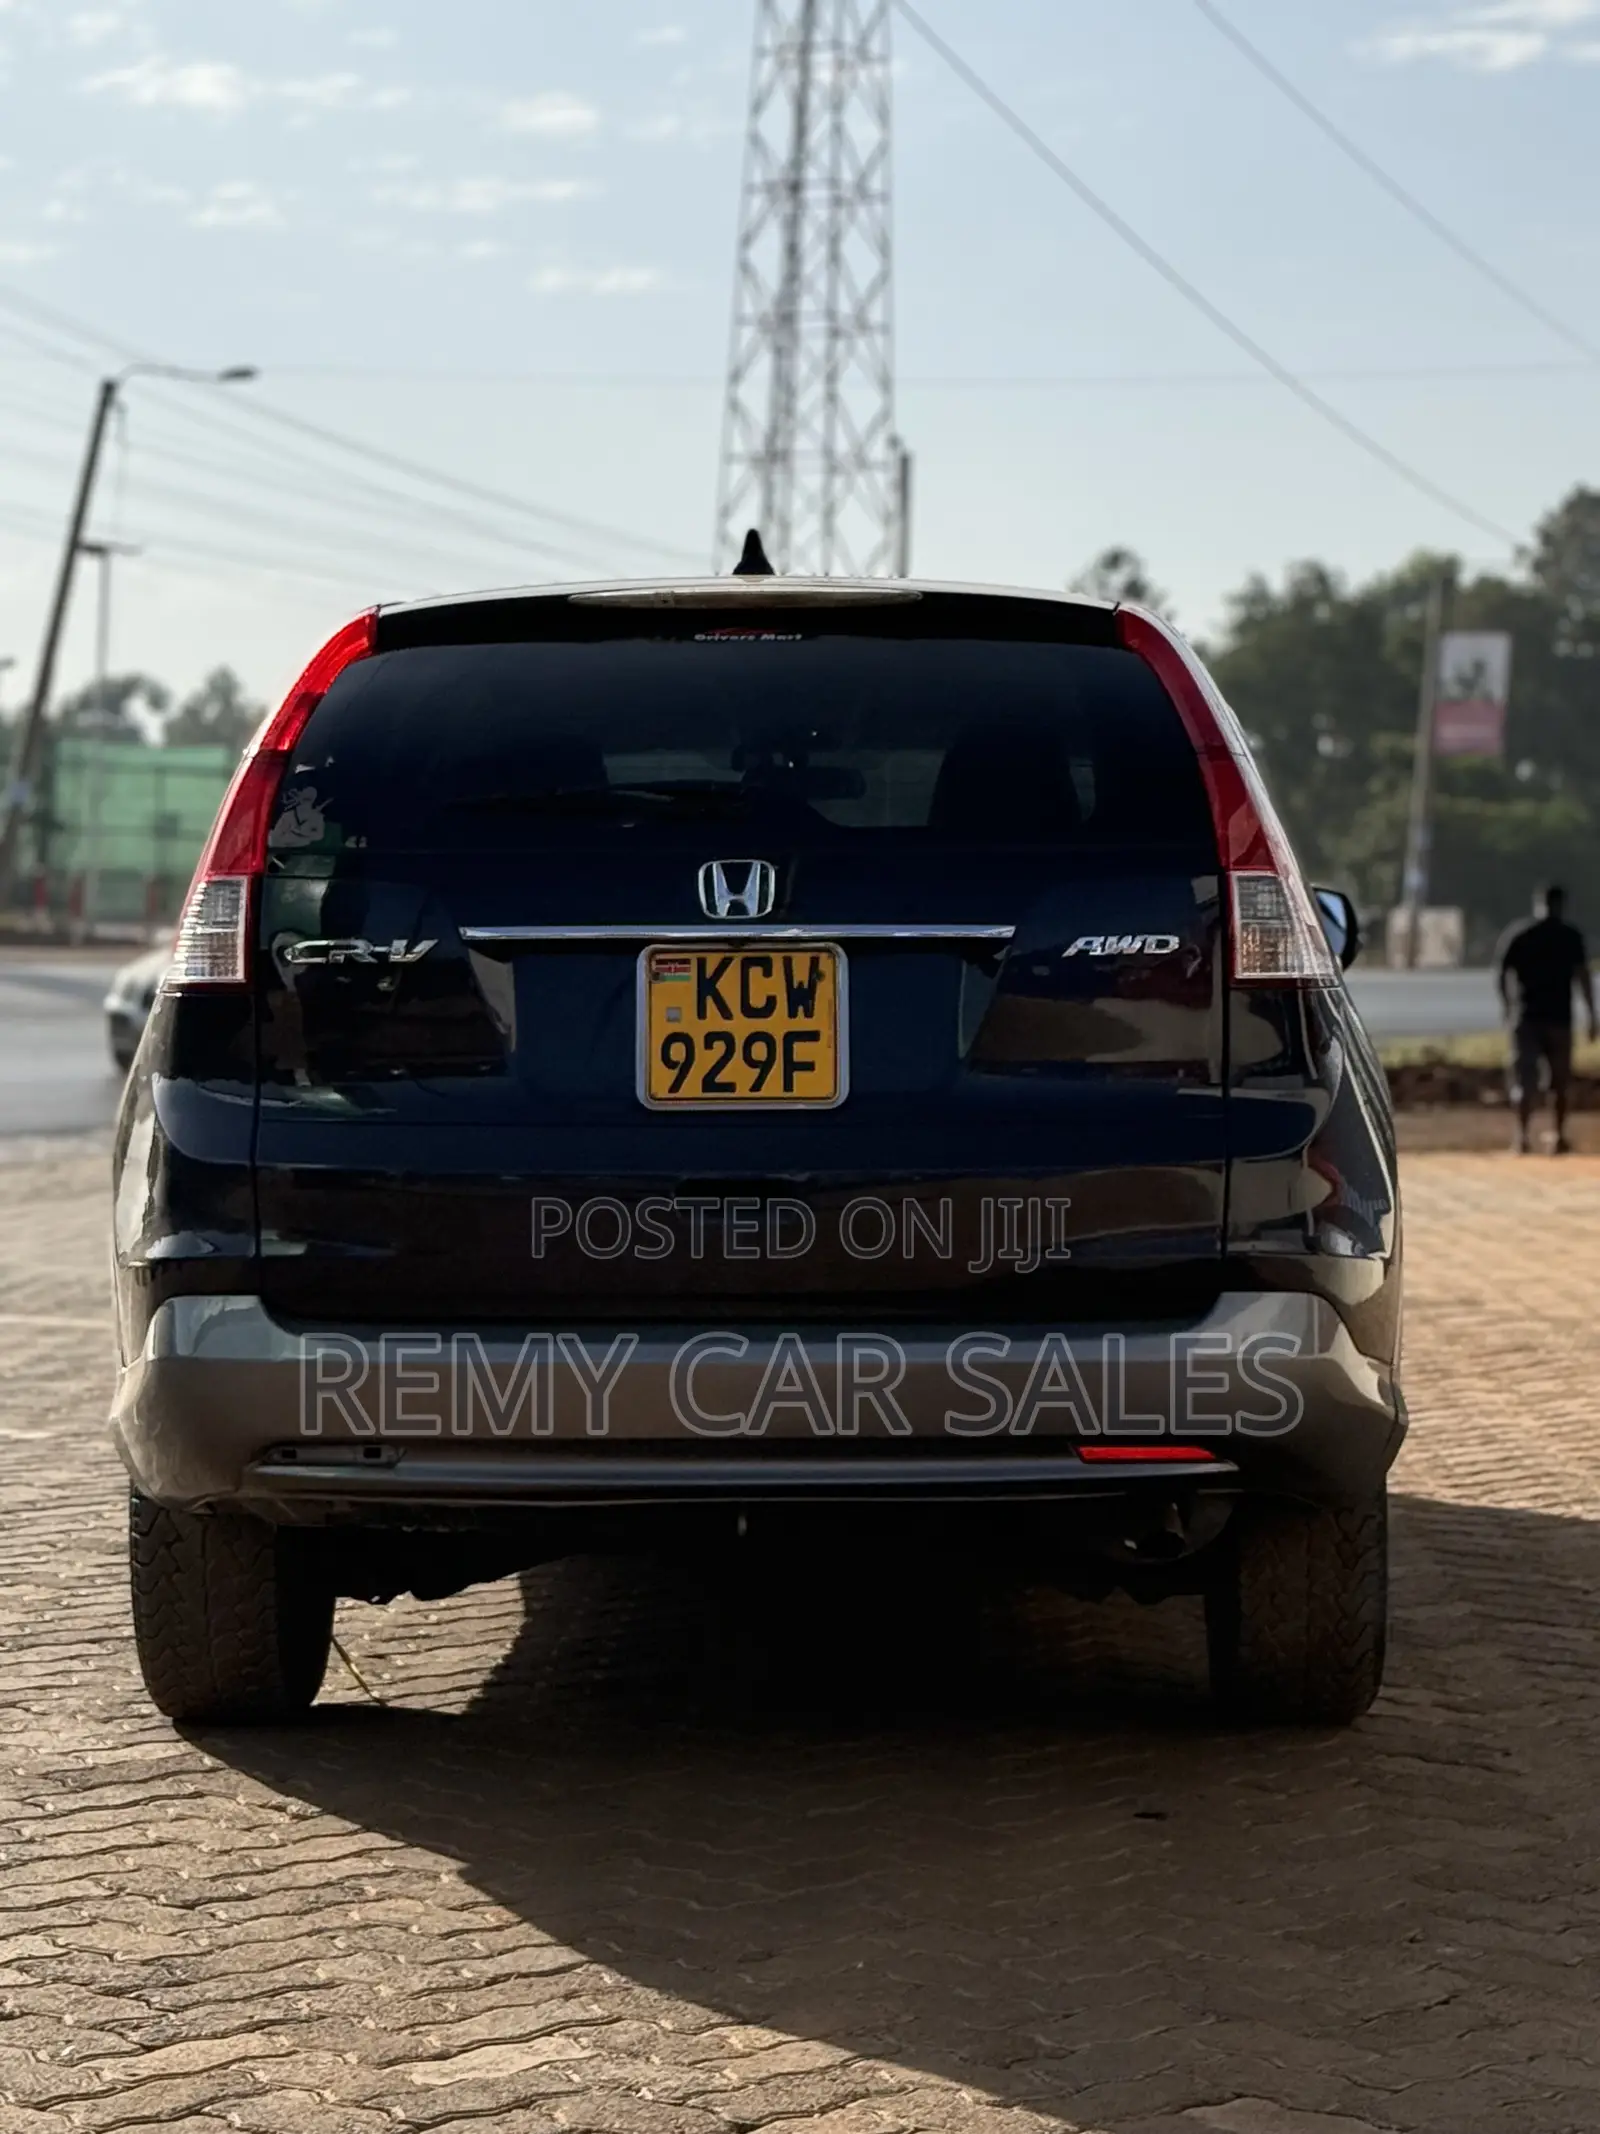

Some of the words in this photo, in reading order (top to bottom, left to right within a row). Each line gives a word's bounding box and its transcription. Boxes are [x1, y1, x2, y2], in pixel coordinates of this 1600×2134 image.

[283, 938, 439, 964] CR-V
[1062, 934, 1180, 958] AWD
[696, 956, 821, 1020] KCW
[660, 1030, 821, 1094] 929F
